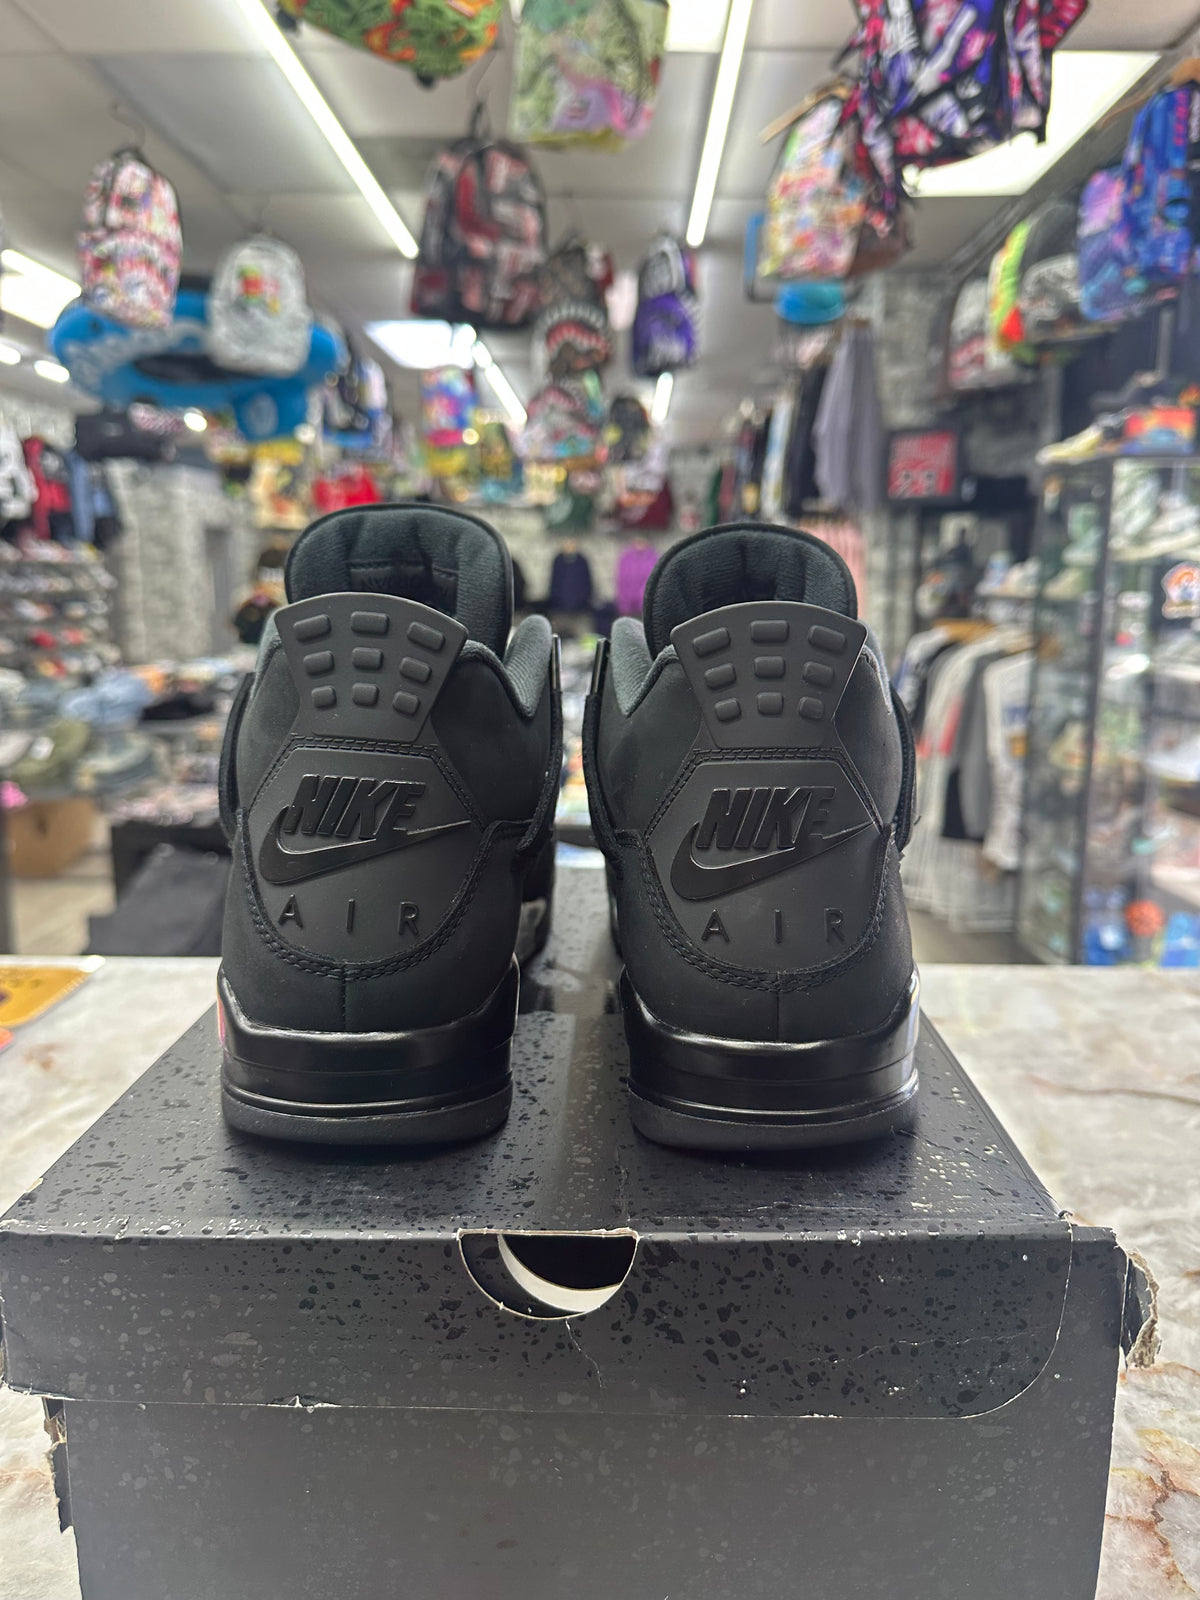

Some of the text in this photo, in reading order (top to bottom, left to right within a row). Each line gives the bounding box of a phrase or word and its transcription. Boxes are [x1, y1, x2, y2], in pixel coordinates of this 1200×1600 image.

[283, 773, 426, 839] NIKE
[695, 786, 836, 850] NIKE
[278, 894, 419, 935] AIR
[701, 908, 845, 943] AIR
